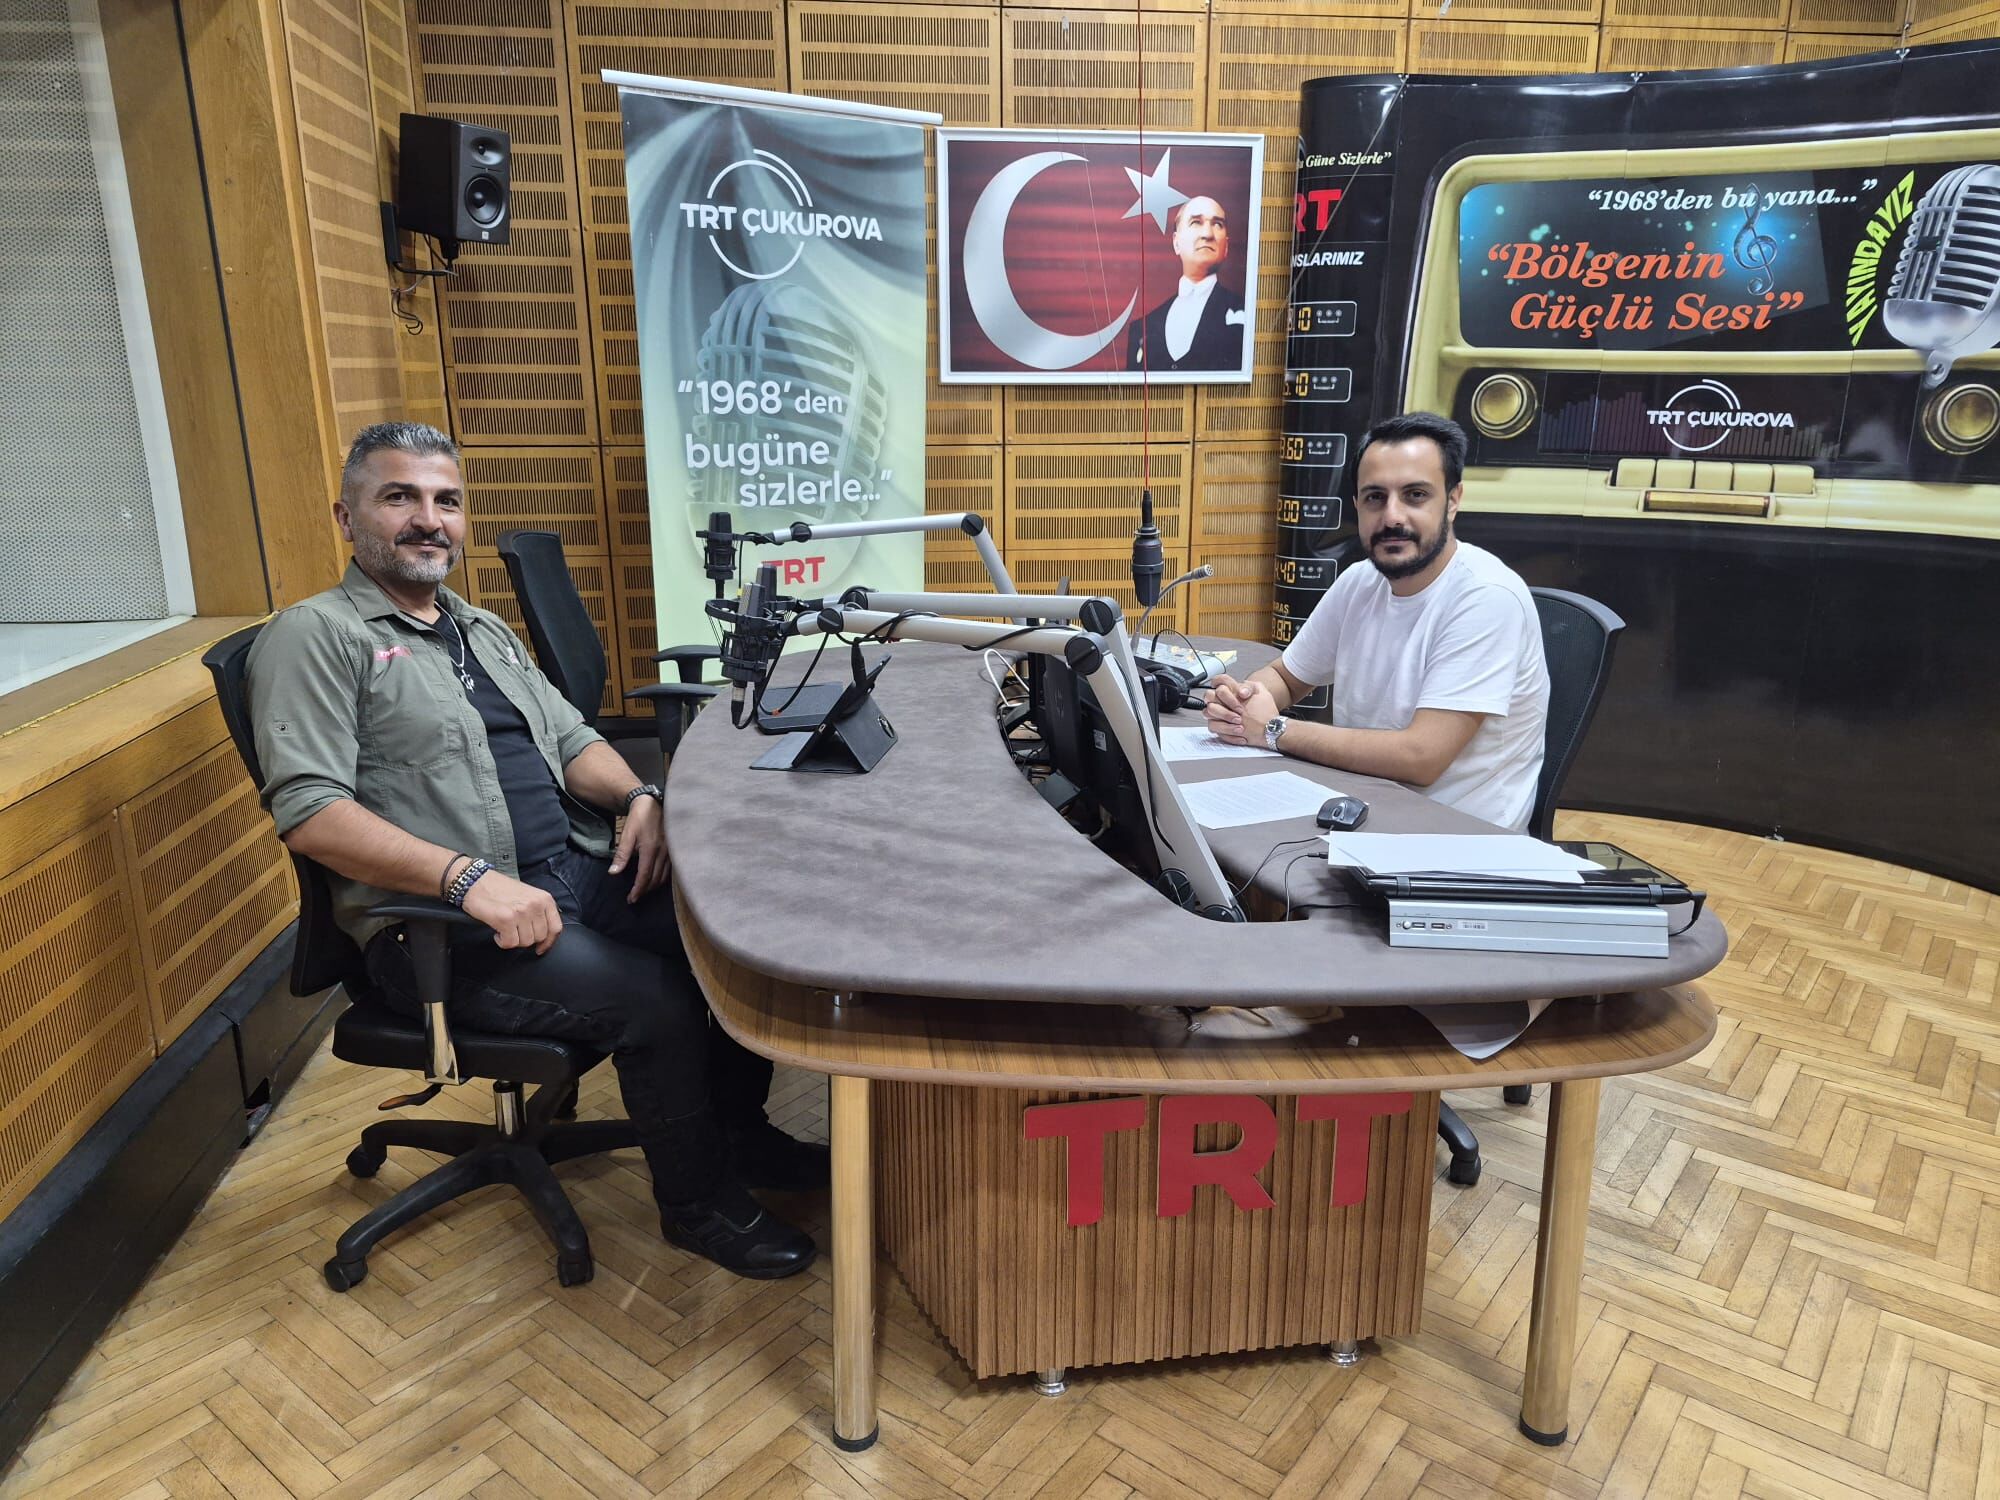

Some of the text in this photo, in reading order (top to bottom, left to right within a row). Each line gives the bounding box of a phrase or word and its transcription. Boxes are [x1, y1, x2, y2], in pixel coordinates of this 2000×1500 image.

[1305, 154, 1336, 168] Güne
[1722, 186, 1757, 209] bu
[680, 203, 883, 242] TRT ÇUKUROVA
[1488, 241, 1727, 288] “Bölgenin
[1846, 170, 1915, 347] YAYINDAYIZ
[1510, 291, 1805, 338] Güçlü Sesi”
[1646, 410, 1795, 428] TRT ÇUKUROVA
[685, 433, 830, 476] bugüne
[1023, 1092, 1414, 1227] TRT
